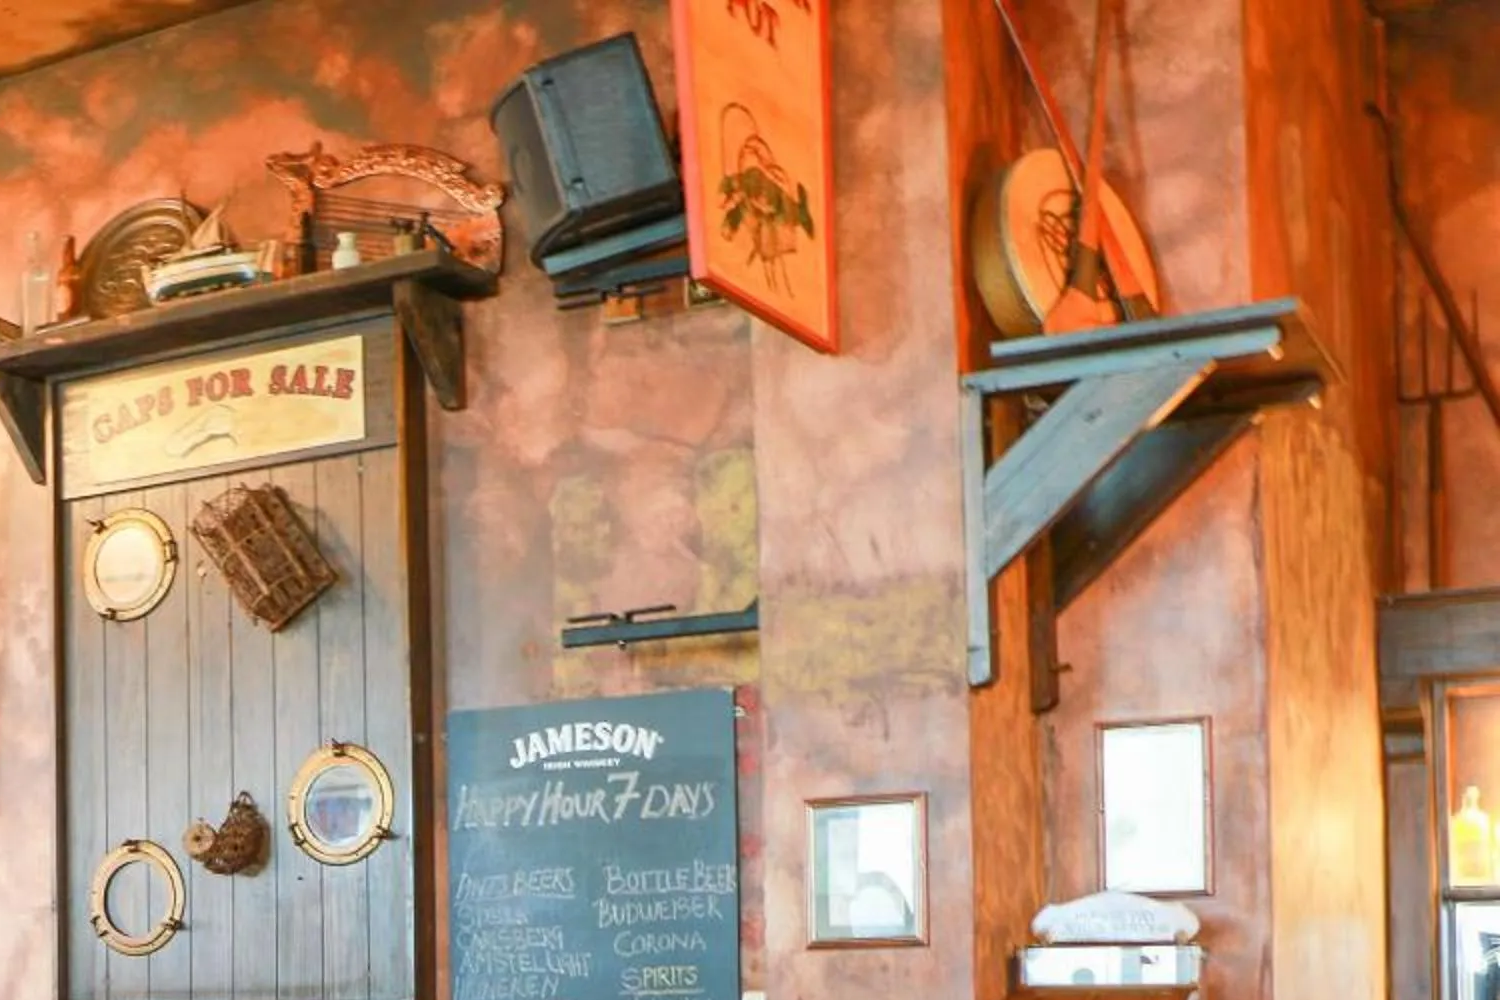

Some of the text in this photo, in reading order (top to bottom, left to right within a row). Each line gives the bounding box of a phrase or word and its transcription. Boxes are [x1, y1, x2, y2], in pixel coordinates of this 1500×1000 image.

[91, 364, 355, 444] CAPS FOR SALE
[509, 720, 658, 769] JAMESON
[453, 770, 717, 831] HAPPY HOUR 7 DAYS
[604, 864, 691, 894] BOTTLE
[594, 894, 724, 930] BUDWEISER
[613, 930, 707, 958] CORONA
[619, 965, 699, 992] SPIRITS
